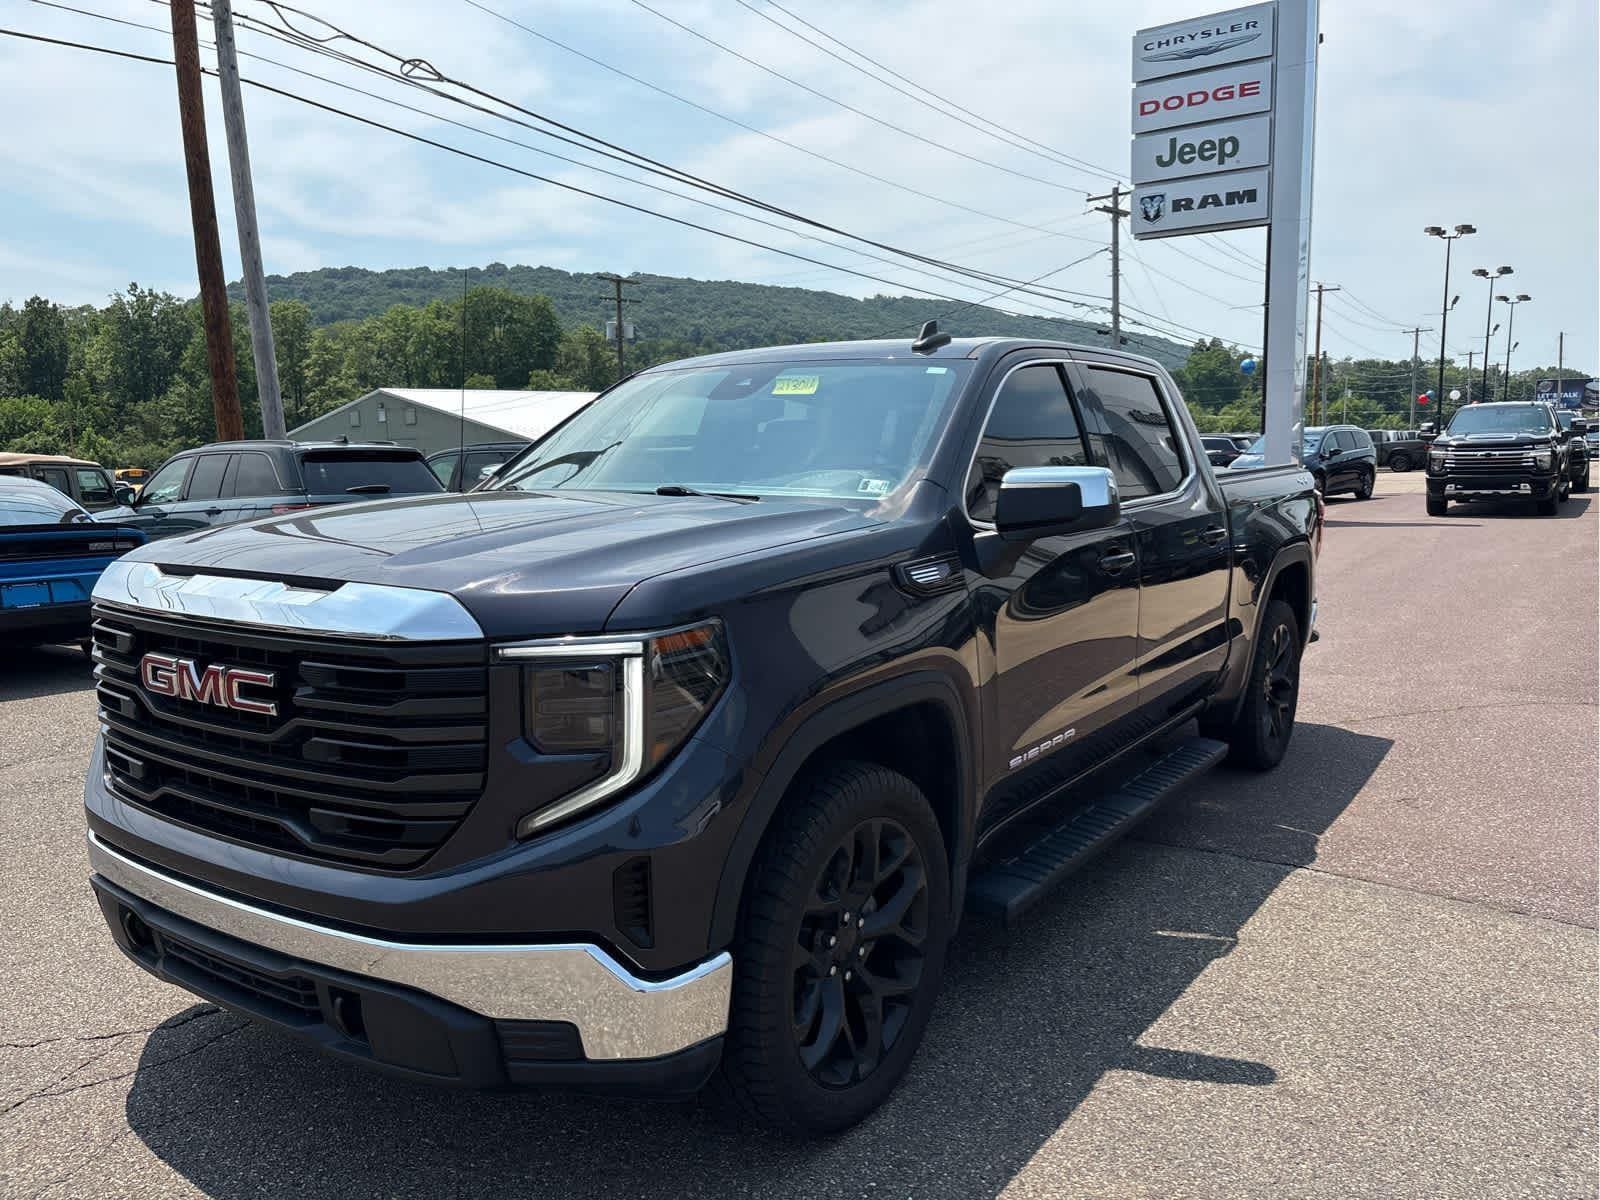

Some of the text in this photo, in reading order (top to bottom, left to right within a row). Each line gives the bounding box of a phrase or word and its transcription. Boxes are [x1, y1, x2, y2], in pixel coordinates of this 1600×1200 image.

[1143, 20, 1259, 51] CHRYSLER
[1139, 80, 1261, 116] DODGE
[1155, 135, 1240, 168] Jeep
[1171, 188, 1257, 213] RAM
[141, 652, 278, 717] GMC
[1008, 728, 1076, 770] SIERRA
